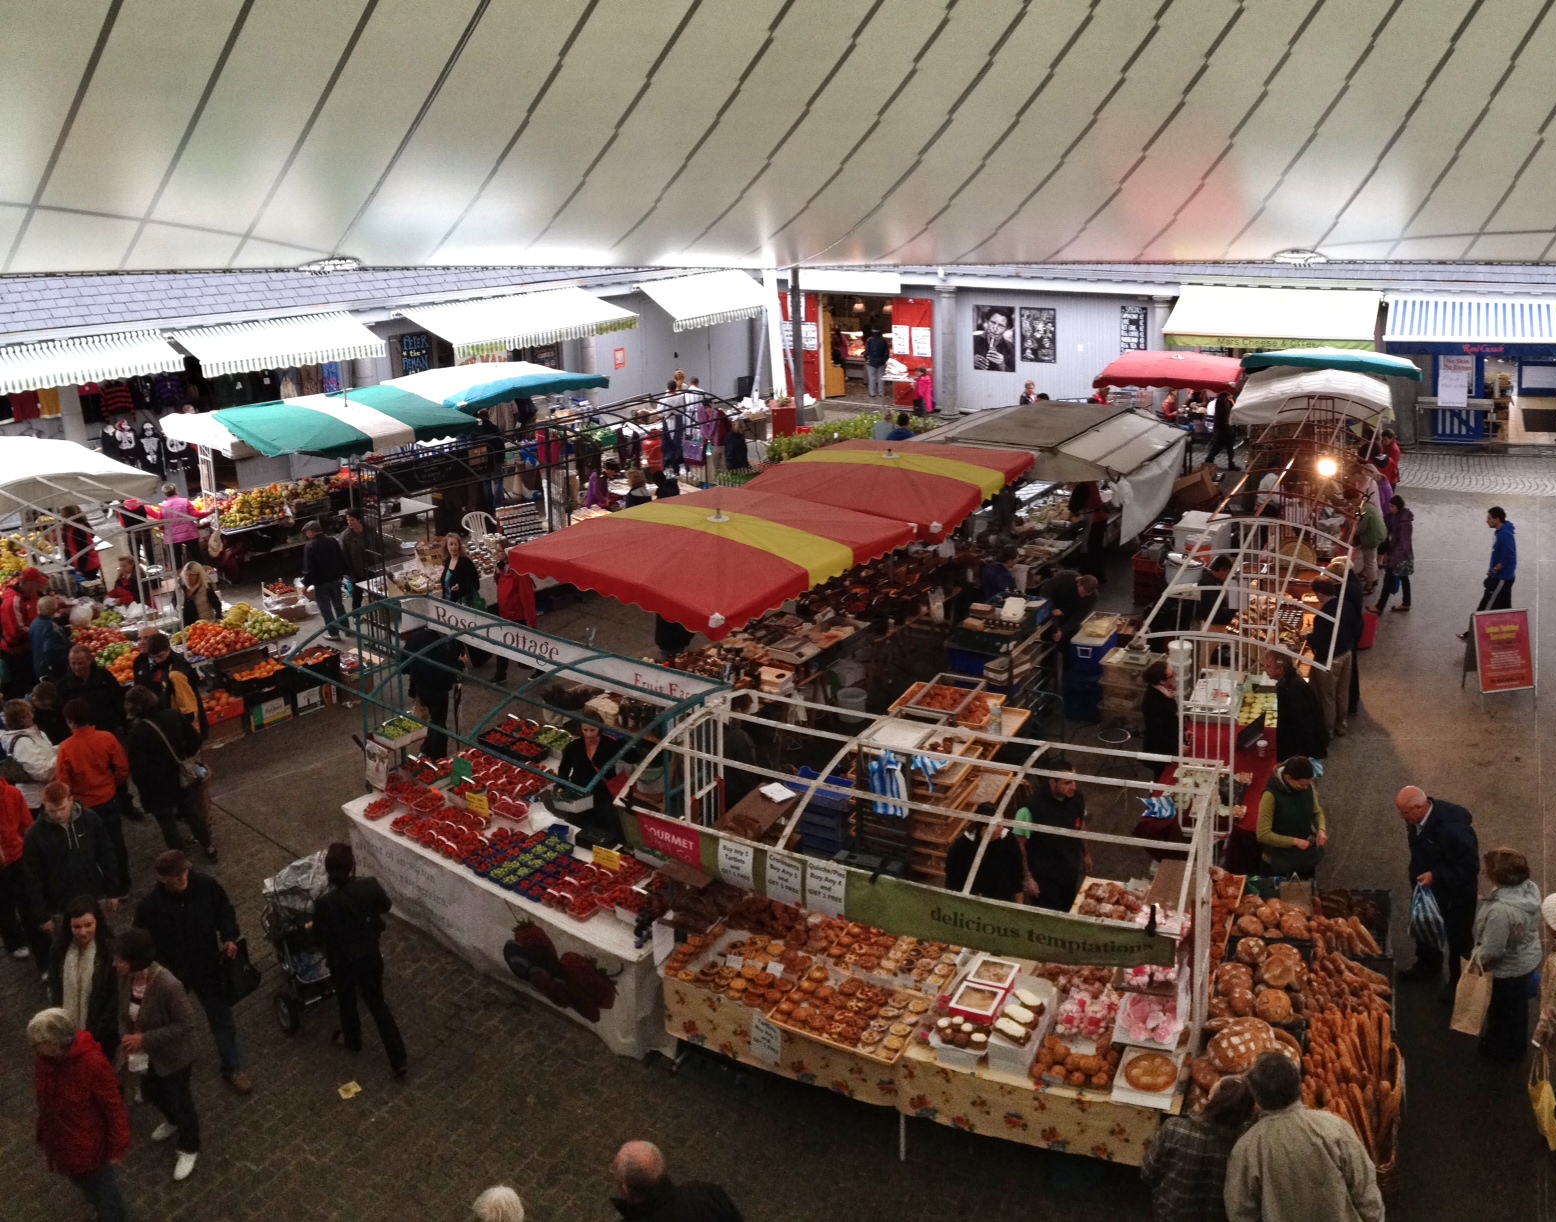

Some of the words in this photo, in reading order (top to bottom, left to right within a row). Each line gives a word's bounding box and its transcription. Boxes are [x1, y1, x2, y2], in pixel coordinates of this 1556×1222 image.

[403, 335, 429, 349] PETER
[1242, 338, 1278, 347] Cheese
[435, 605, 478, 633] Rose
[486, 625, 560, 667] Cottage
[634, 672, 664, 693] Fruit
[668, 682, 699, 700] Far
[644, 824, 694, 850] OURMET
[723, 845, 733, 853] Buy
[769, 854, 800, 871] Croissants
[737, 873, 750, 881] FREE
[770, 864, 780, 873] Buy
[782, 869, 793, 878] Any
[768, 879, 779, 887] GET
[785, 885, 799, 894] FREE
[810, 872, 823, 882] Buy
[824, 876, 836, 886] Any
[808, 888, 821, 897] GET
[827, 894, 842, 903] FREE
[930, 907, 1021, 940] delicious
[1027, 929, 1154, 955] temptations
